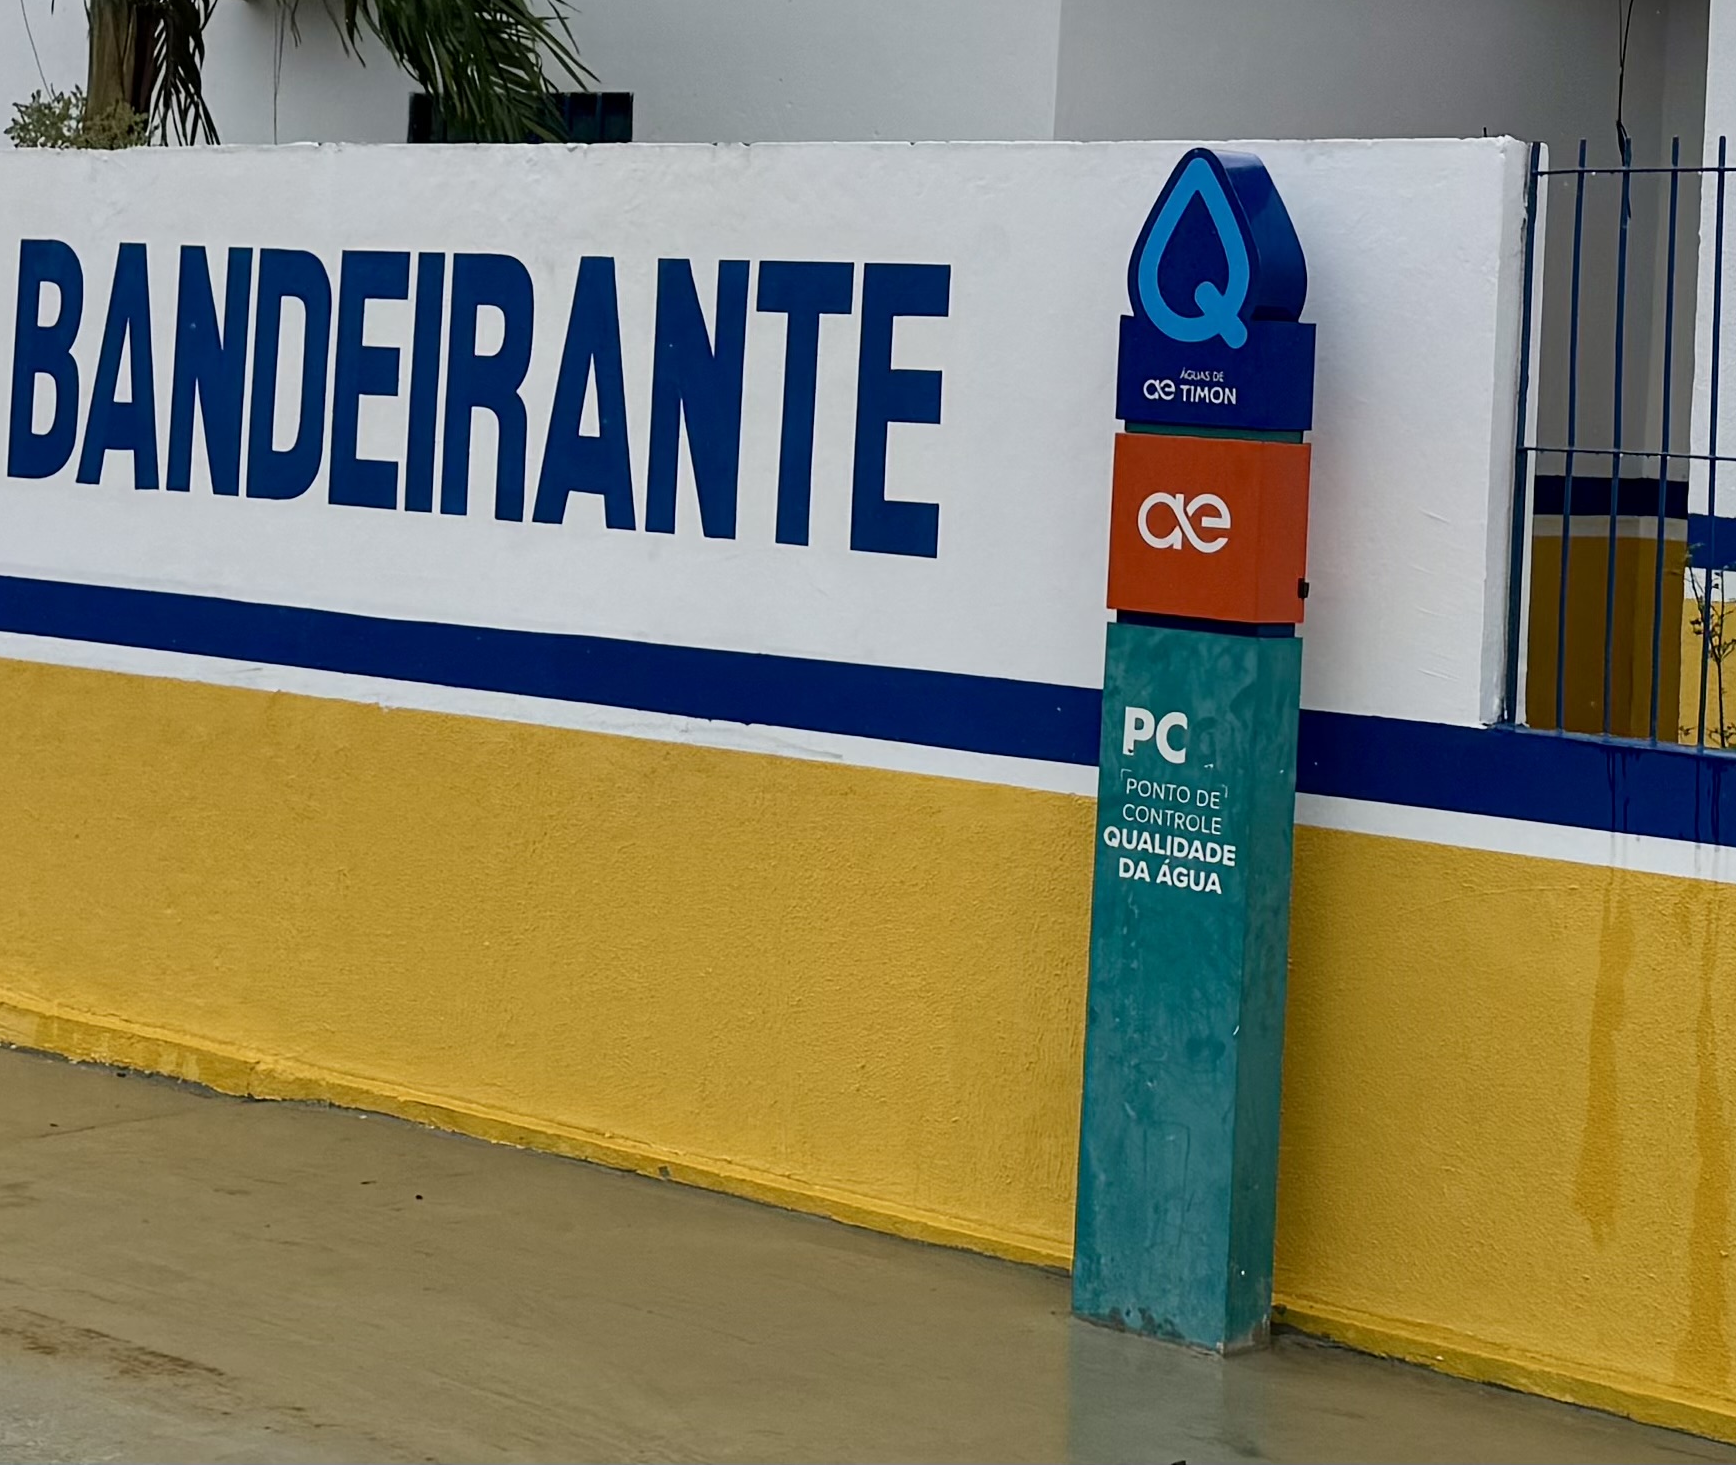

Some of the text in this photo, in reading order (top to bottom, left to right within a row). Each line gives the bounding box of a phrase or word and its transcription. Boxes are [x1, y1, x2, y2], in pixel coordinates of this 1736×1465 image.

[7, 238, 952, 559] BANDEIRANTE
[1180, 385, 1236, 405] TIMON
[1123, 706, 1188, 764] PC
[1126, 778, 1220, 809] PONTO DE
[1123, 804, 1222, 835] CONTROLE
[1103, 826, 1236, 867] QUALIDADE
[1119, 857, 1222, 895] DA ÁGUA
